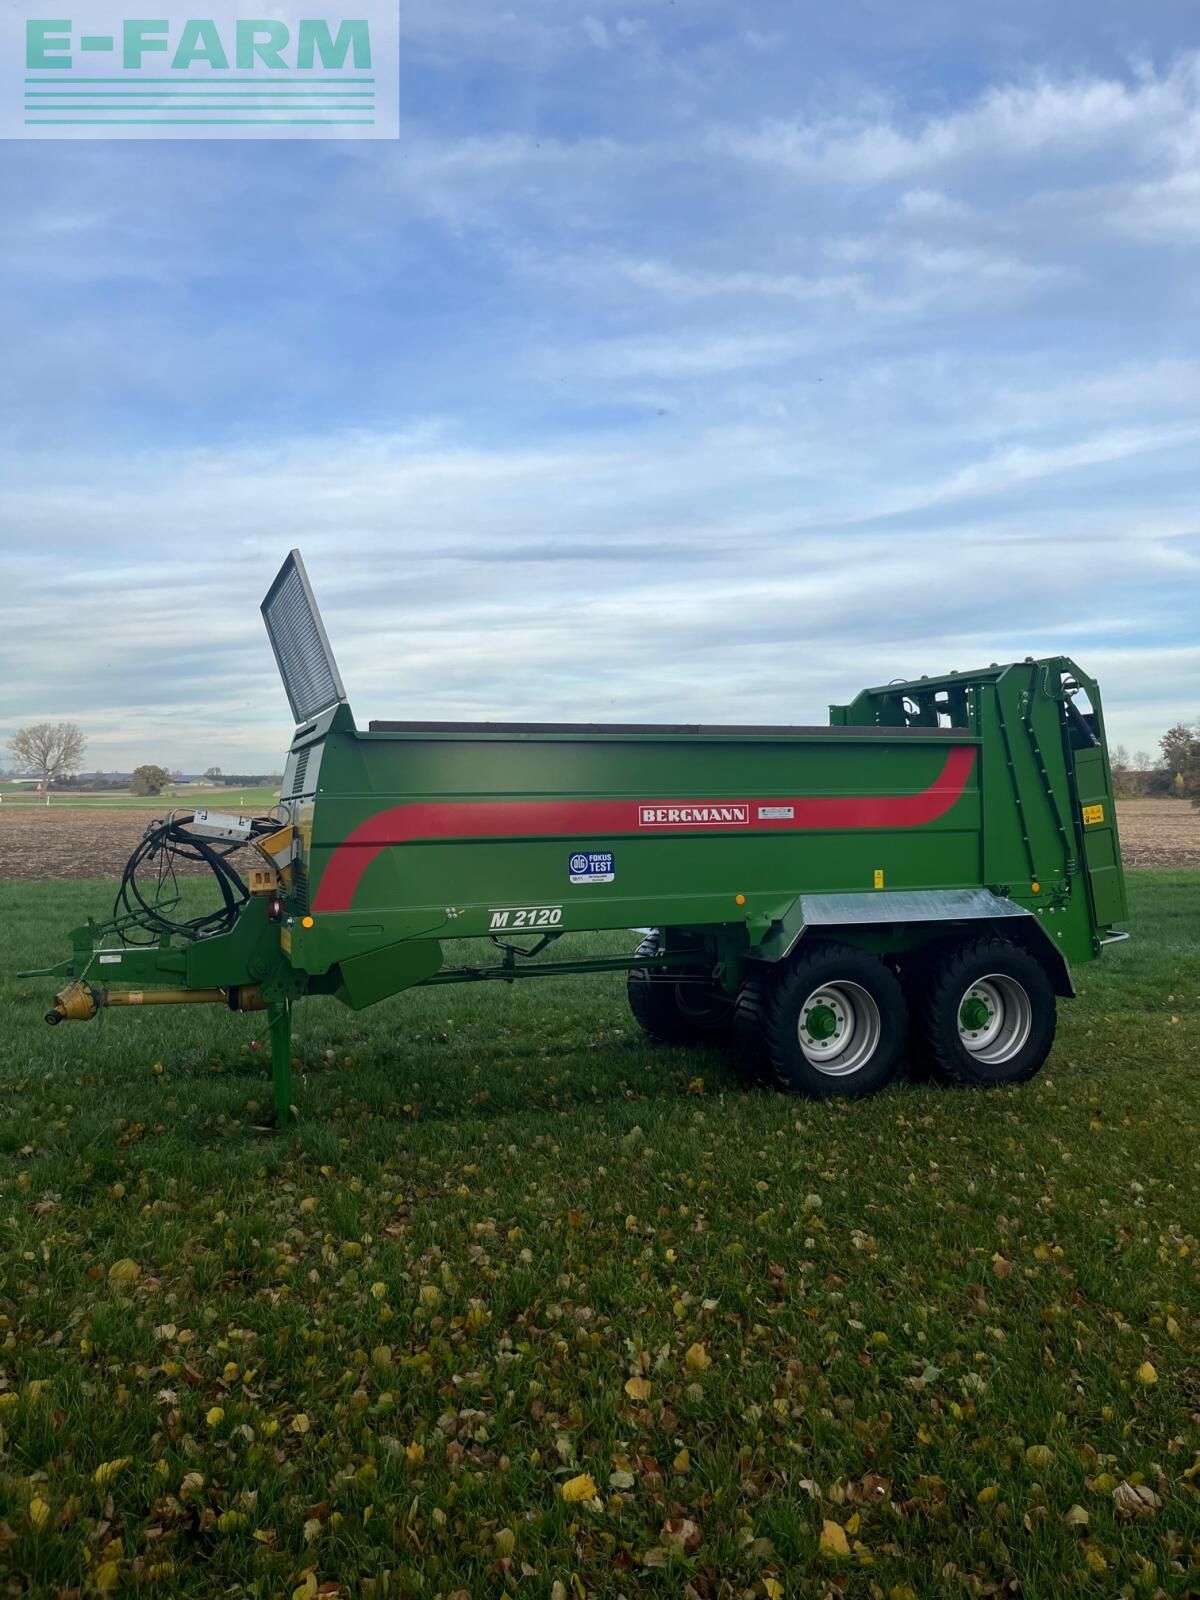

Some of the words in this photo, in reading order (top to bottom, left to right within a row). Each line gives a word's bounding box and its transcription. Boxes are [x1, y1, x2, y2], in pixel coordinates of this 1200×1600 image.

[643, 808, 745, 822] BERGMANN
[589, 854, 612, 862] FOKUS
[589, 862, 612, 872] TEST
[490, 912, 510, 928] M
[512, 909, 562, 926] 2120
